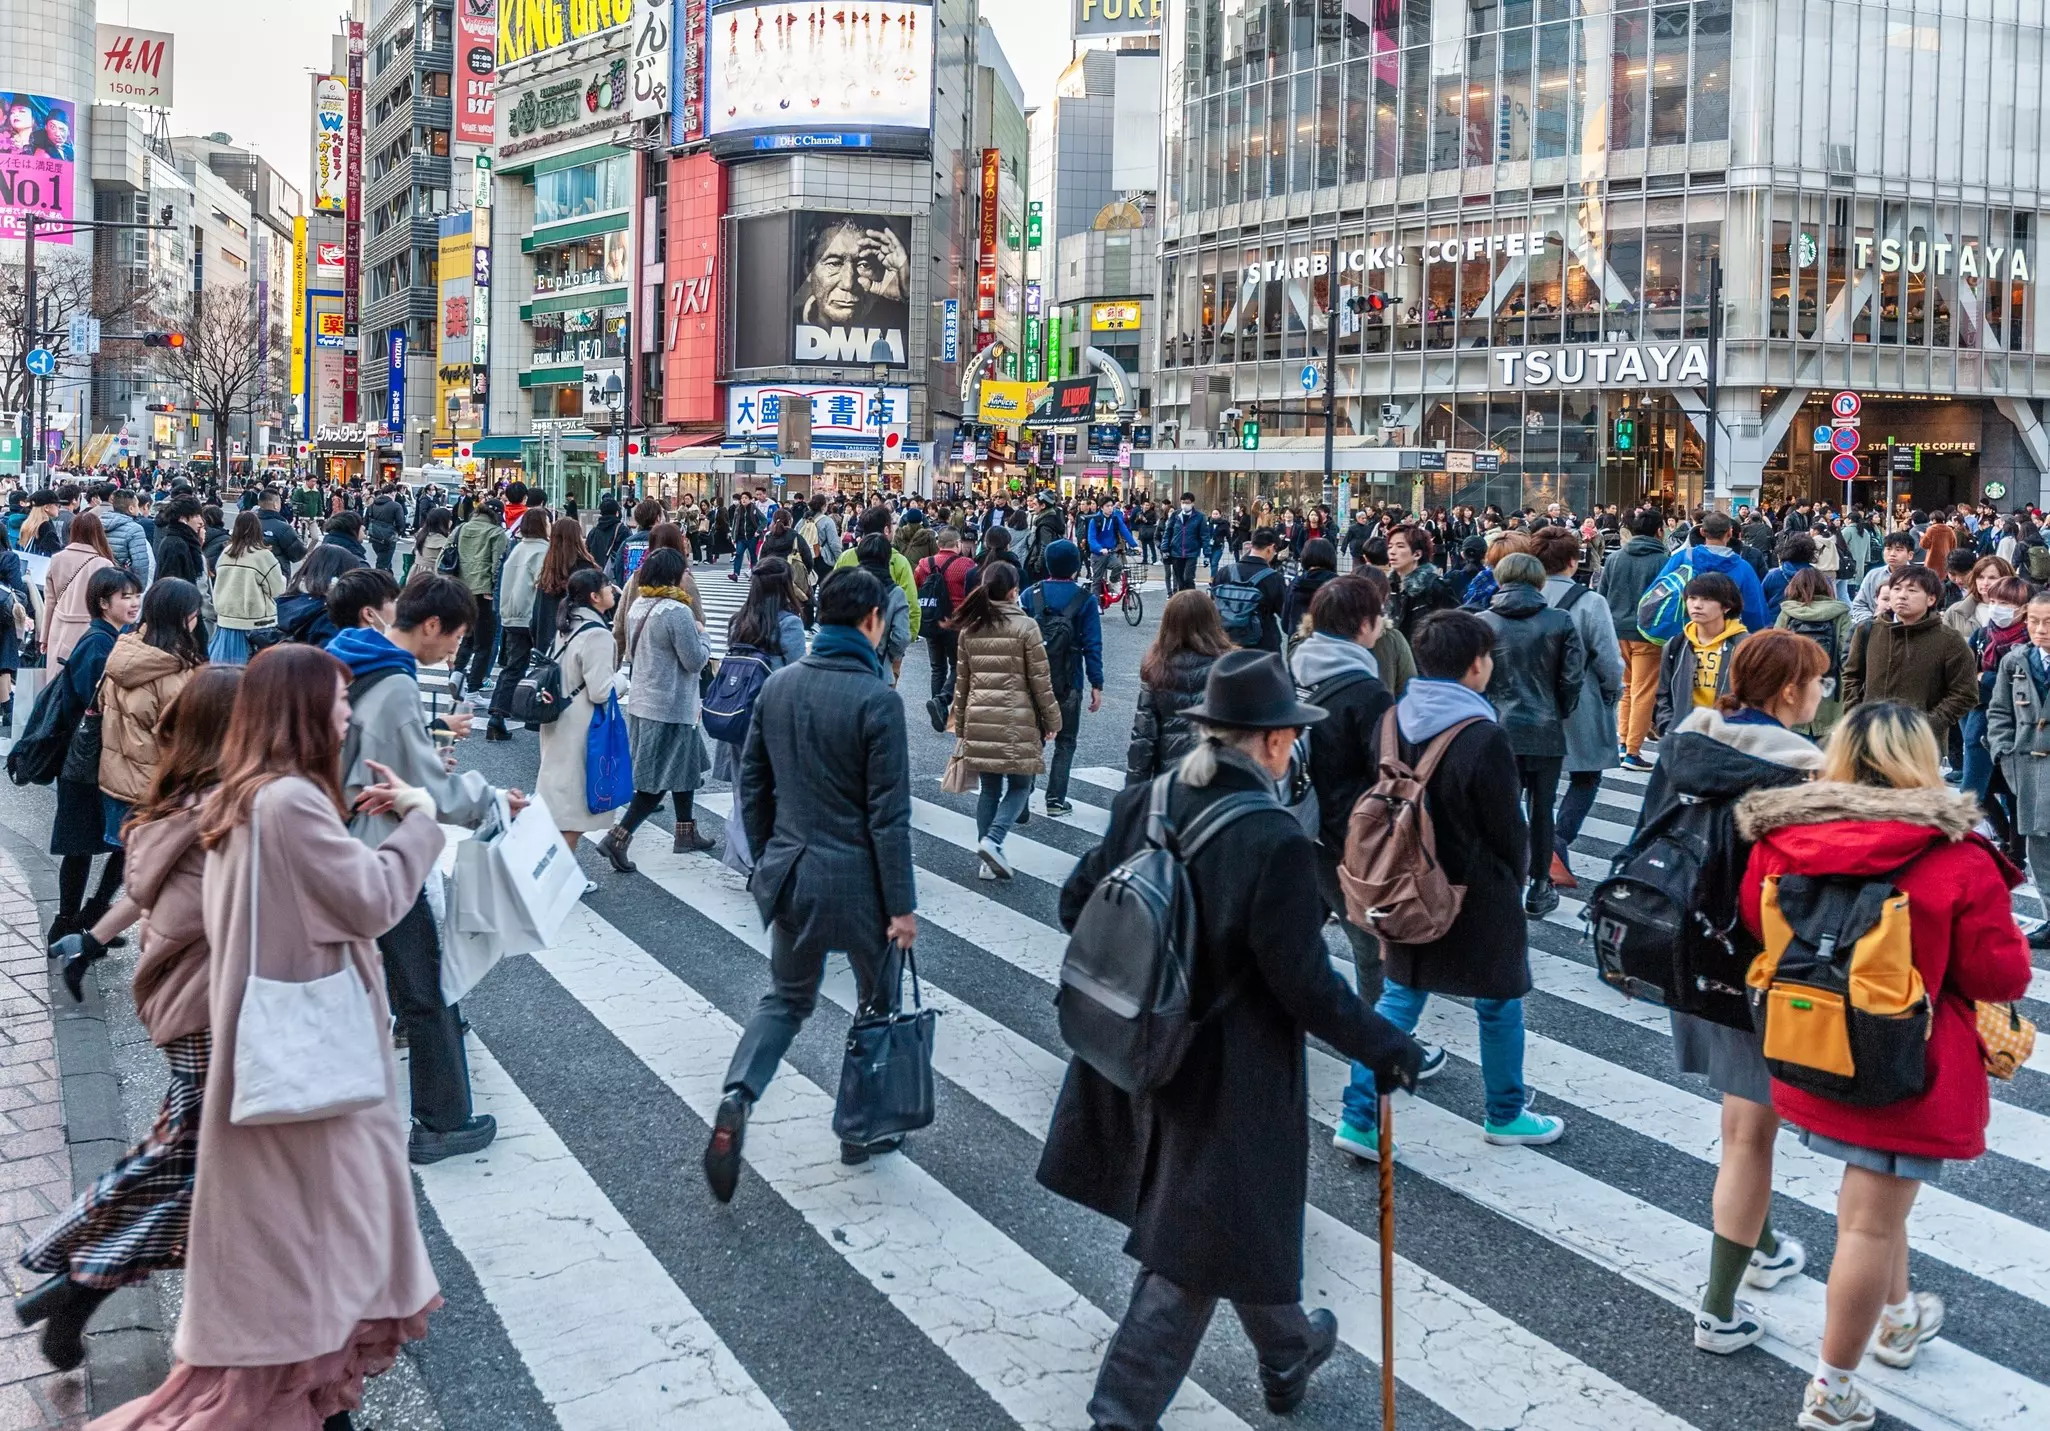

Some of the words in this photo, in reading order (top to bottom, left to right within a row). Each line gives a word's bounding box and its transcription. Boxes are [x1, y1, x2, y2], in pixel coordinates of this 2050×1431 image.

[498, 0, 564, 65] KING
[104, 36, 165, 78] H&M
[634, 0, 667, 110] んじゃ
[780, 136, 801, 146] DHC
[803, 135, 843, 145] Channel
[0, 169, 63, 211] No.1
[1419, 232, 1545, 264] COFFEE
[1854, 237, 2029, 281] TSUTAYA
[537, 270, 601, 292] Euphoria
[979, 253, 996, 311] 三千里
[1496, 345, 1709, 385] TSUTAYA
[316, 424, 366, 443] グルメタウン
[1932, 442, 1976, 450] COFFEE
